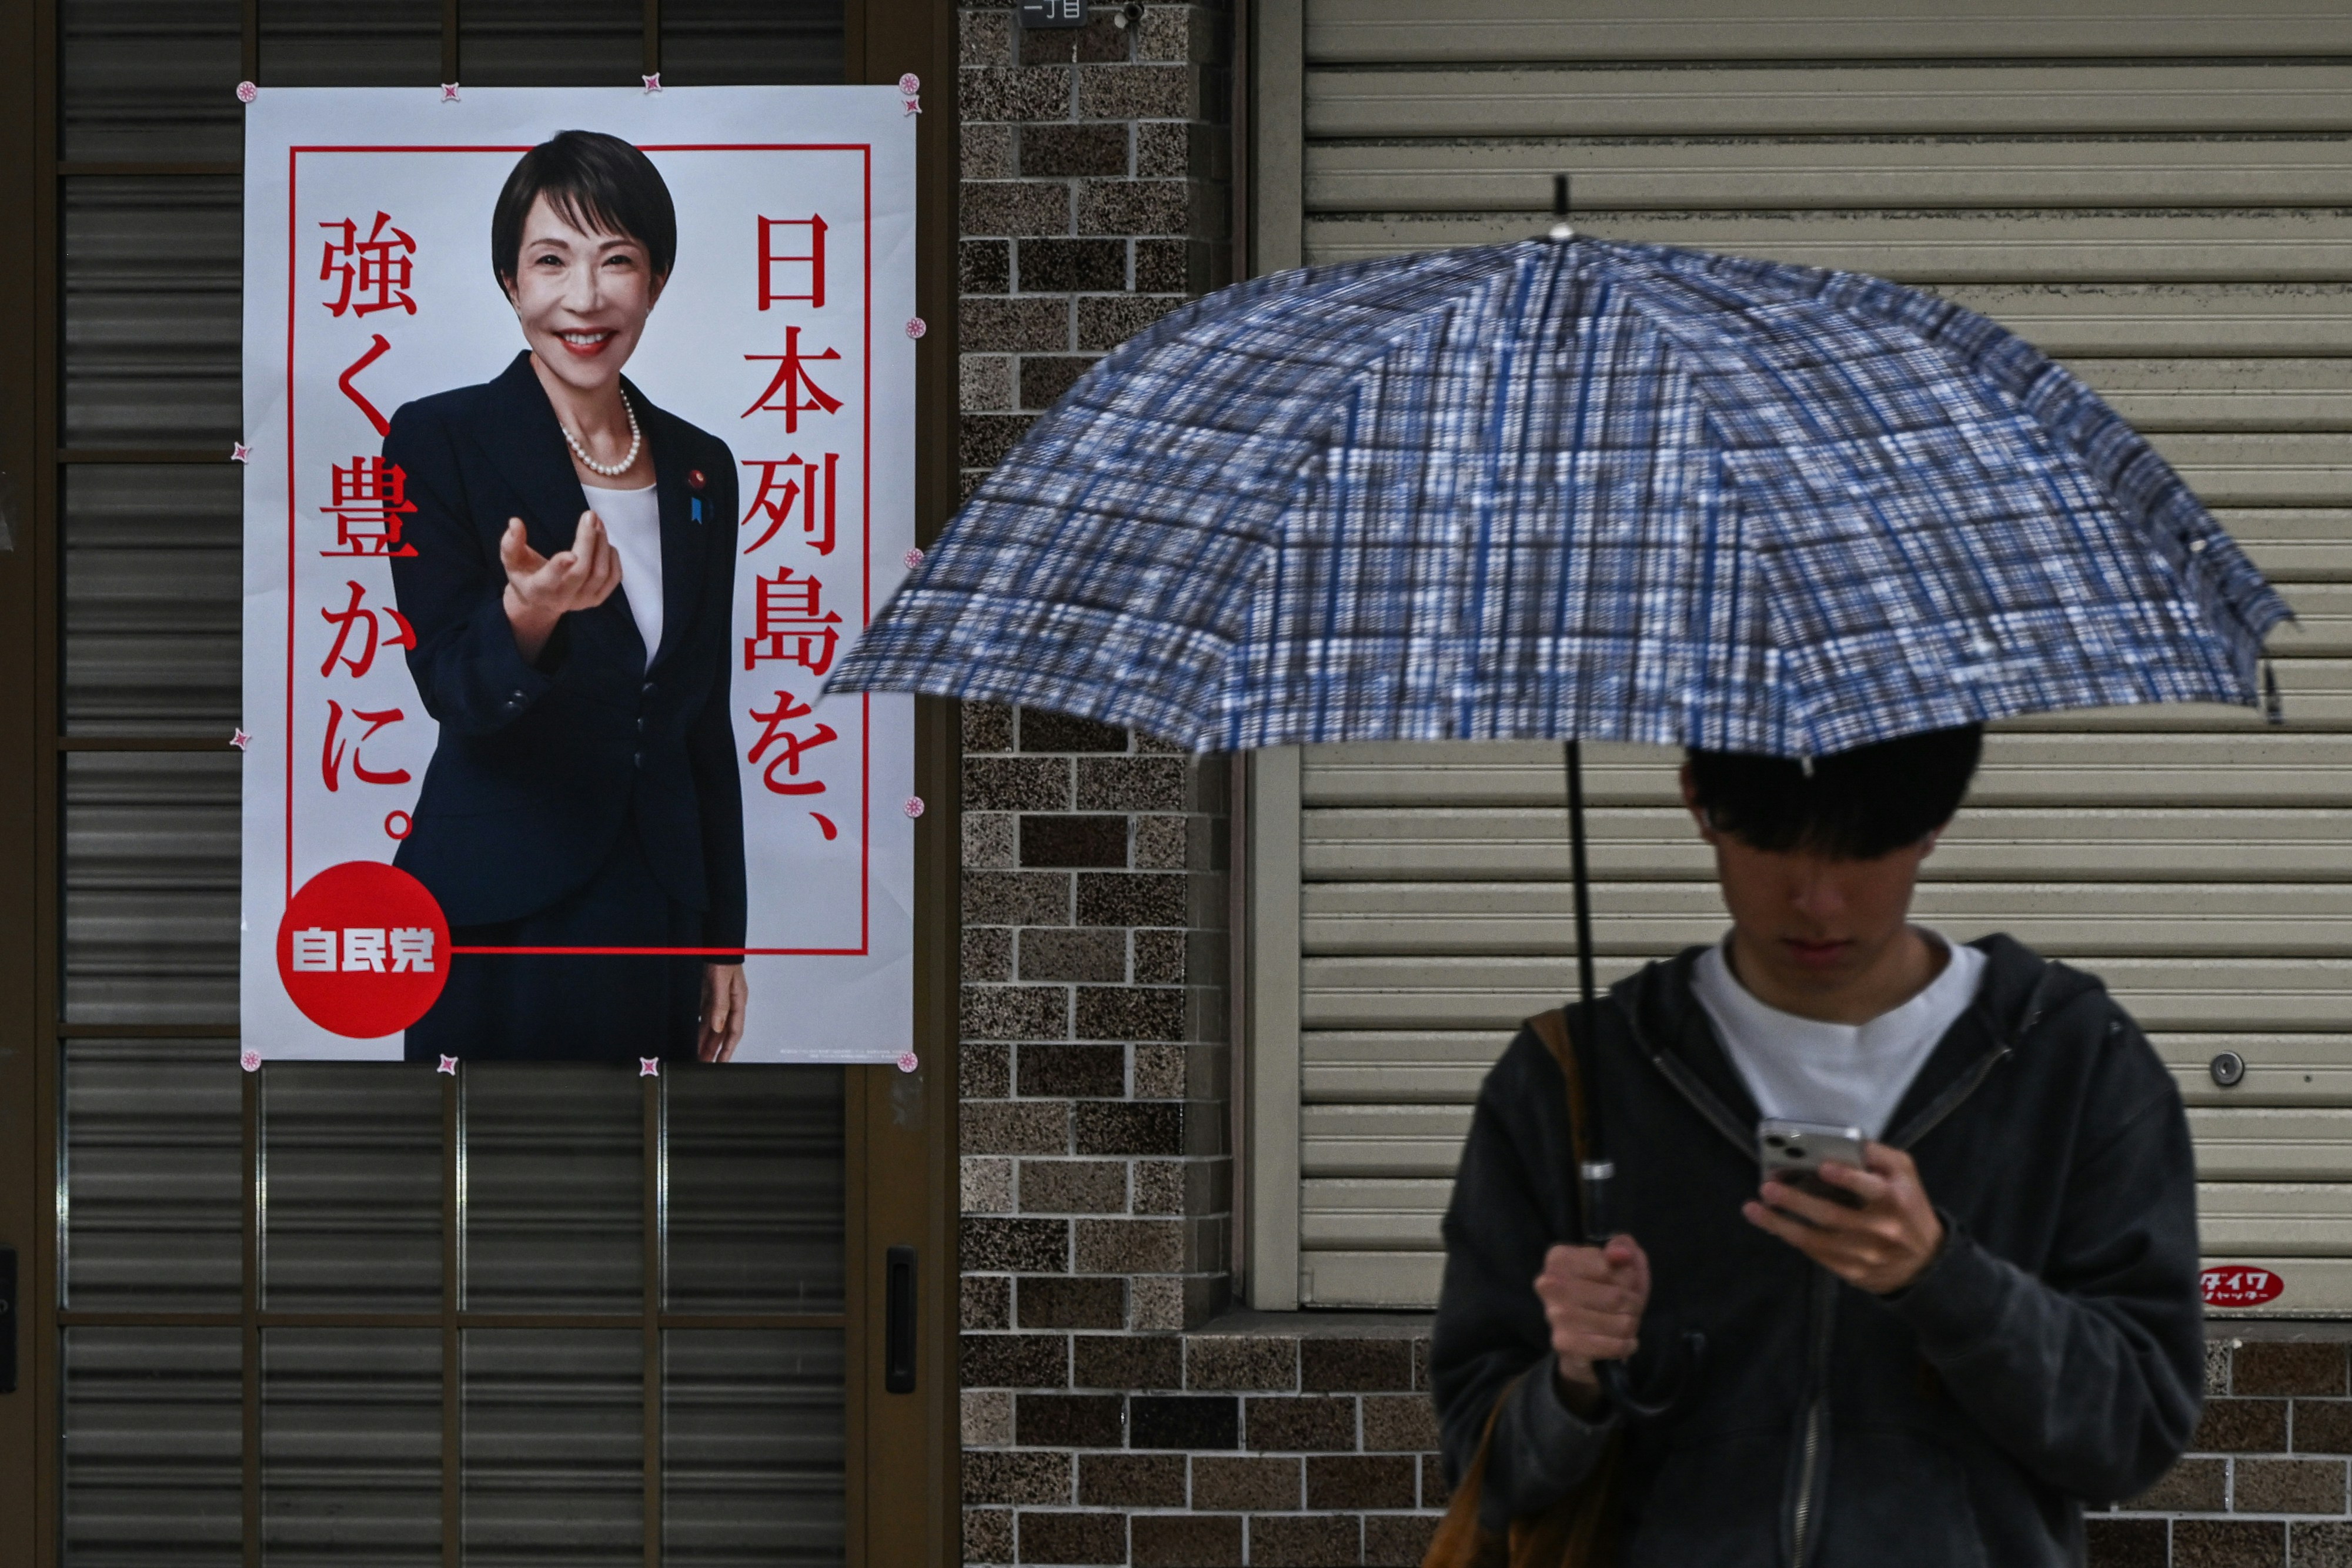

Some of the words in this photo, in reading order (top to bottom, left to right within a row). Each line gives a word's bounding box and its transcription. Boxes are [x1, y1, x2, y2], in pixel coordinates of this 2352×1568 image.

[319, 210, 419, 840] 強く豊かに。
[741, 212, 844, 841] 日本列島を、
[293, 927, 435, 972] 自民党
[2200, 1273, 2269, 1290] ダイワ
